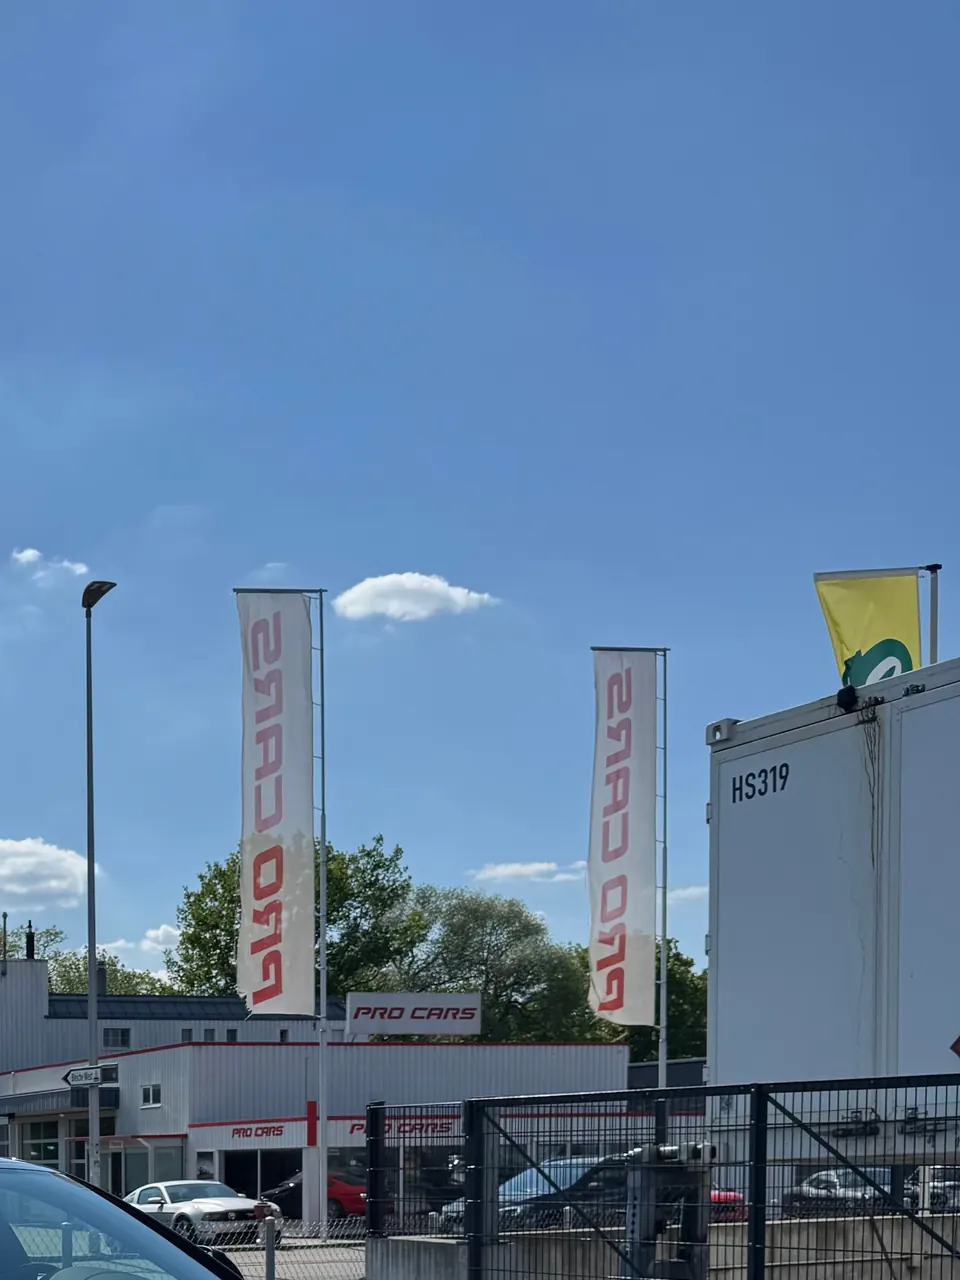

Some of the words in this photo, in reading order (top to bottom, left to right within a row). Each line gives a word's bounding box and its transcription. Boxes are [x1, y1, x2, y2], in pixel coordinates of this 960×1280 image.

[732, 762, 790, 804] HS319
[352, 1007, 405, 1020] PRO
[410, 1007, 478, 1020] CARS
[232, 1127, 253, 1138] PRO
[254, 1125, 285, 1137] CARS
